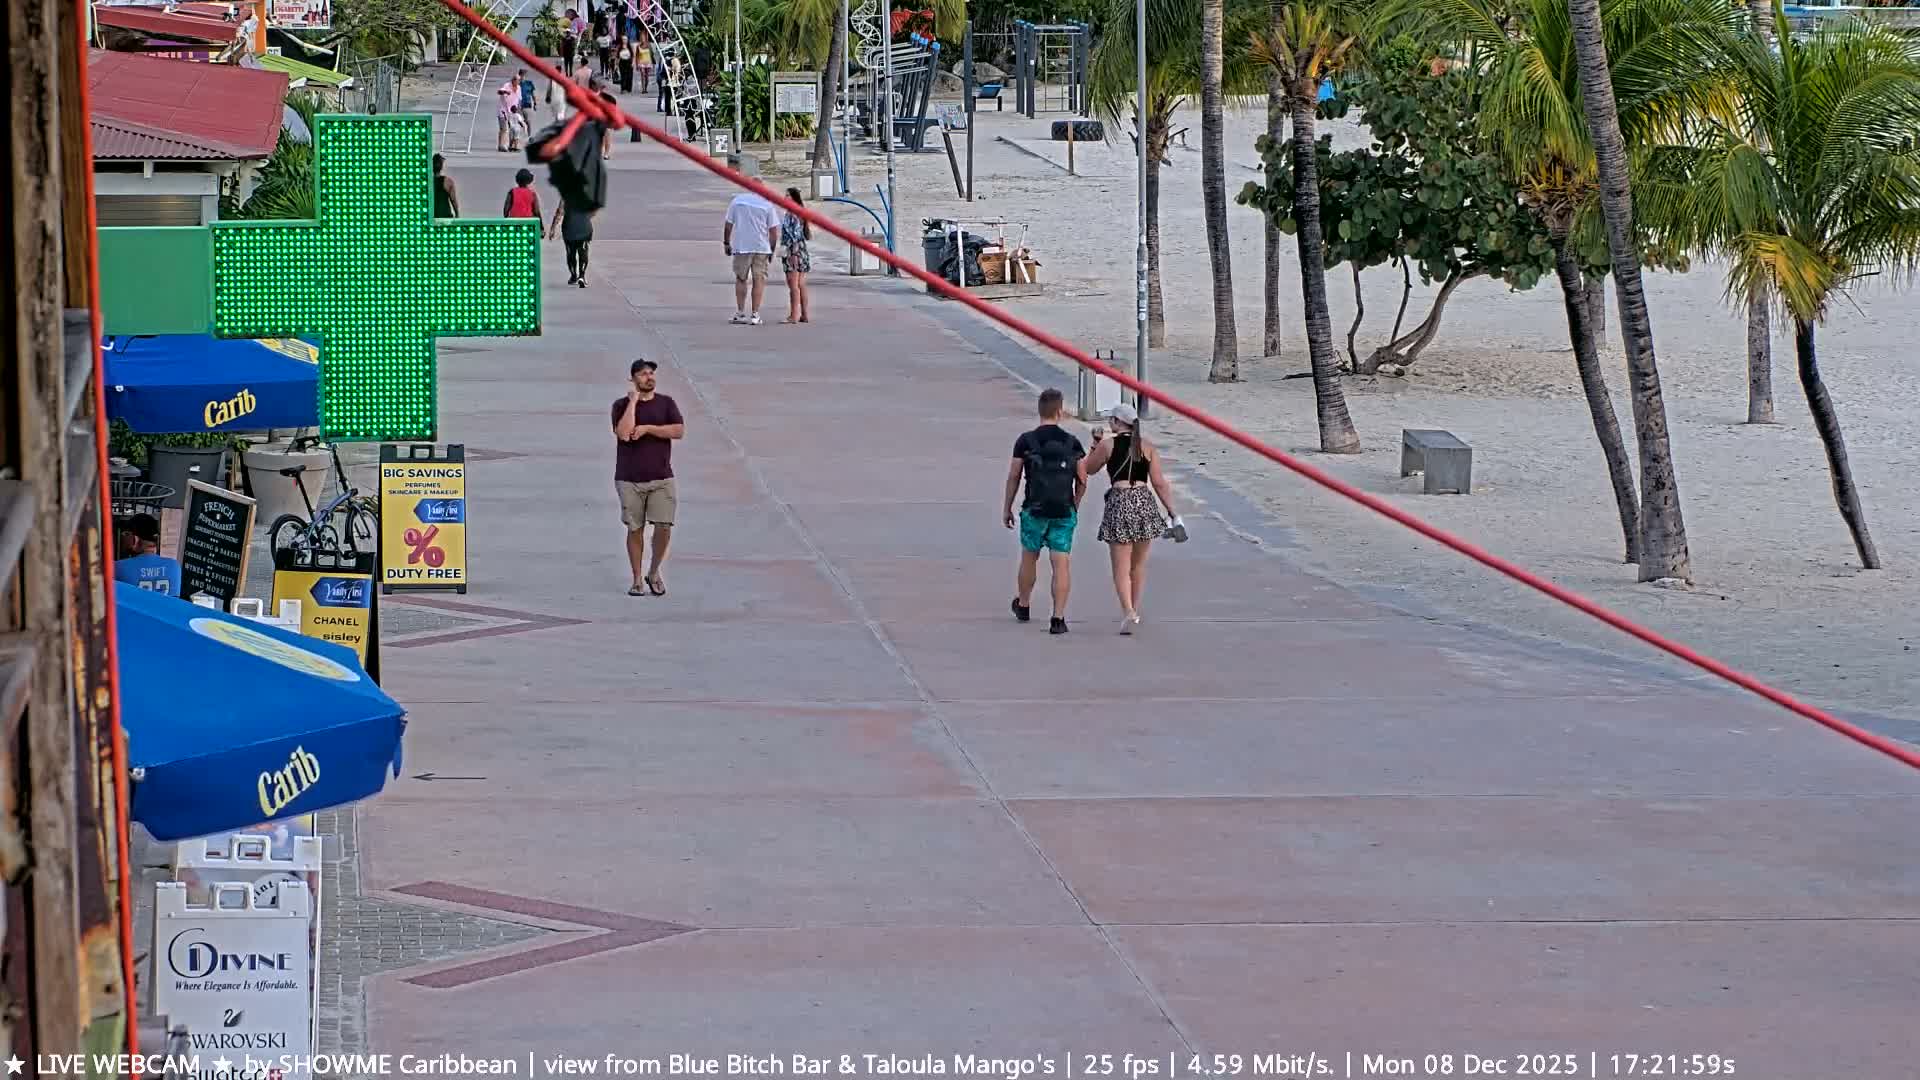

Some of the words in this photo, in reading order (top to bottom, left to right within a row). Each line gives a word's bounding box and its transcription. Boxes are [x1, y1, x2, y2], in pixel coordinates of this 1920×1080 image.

[204, 388, 256, 428] Carib
[383, 468, 404, 478] BIG
[408, 468, 463, 478] SAVINGS
[204, 501, 235, 520] FRENCH
[199, 513, 236, 531] SUPERMARKET
[140, 566, 166, 578] SWIFT
[184, 562, 204, 575] WINES
[210, 572, 235, 585] SPIRITS
[387, 568, 424, 579] DUTY
[427, 568, 462, 579] FREE
[190, 579, 205, 589] AND
[205, 583, 225, 596] MORE
[313, 616, 359, 626] CHANEL
[322, 632, 361, 644] sisley
[258, 745, 320, 817] Carib
[168, 928, 294, 978] DIVINE
[175, 981, 202, 990] Where
[203, 980, 241, 992] Elegance
[243, 980, 251, 989] Is
[253, 979, 299, 992] Affordable.
